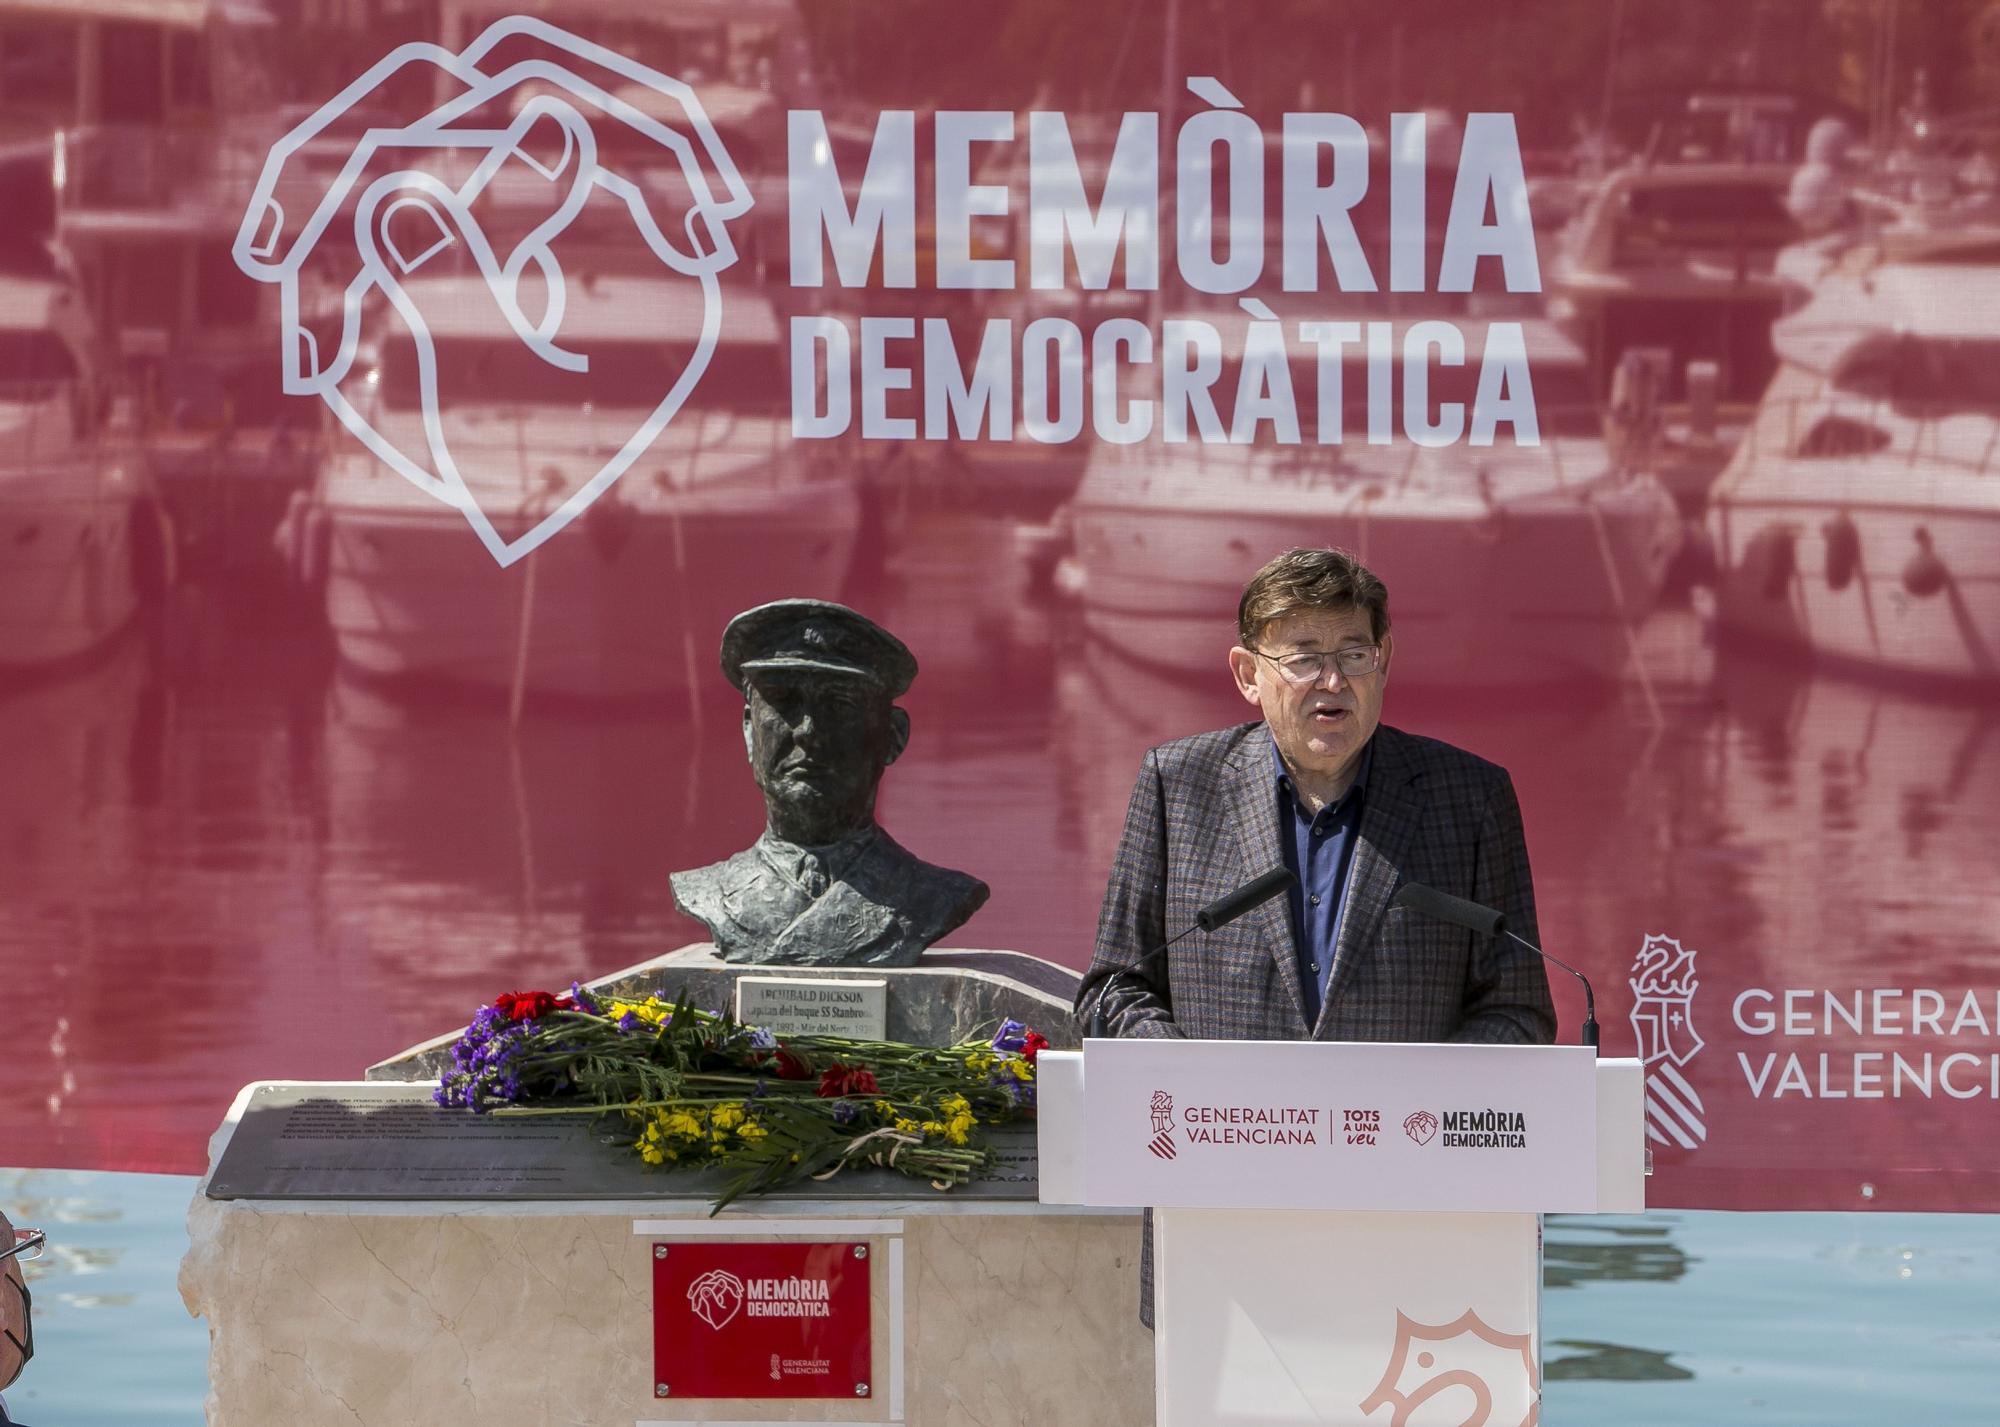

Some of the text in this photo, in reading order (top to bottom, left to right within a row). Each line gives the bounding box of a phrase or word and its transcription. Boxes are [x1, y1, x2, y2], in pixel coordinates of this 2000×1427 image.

[788, 77, 1543, 293] MEMÒRIA
[789, 298, 1542, 447] DEMOCRÀTICA
[819, 990, 864, 1003] DICKSON
[821, 1006, 831, 1018] SS
[832, 1006, 873, 1018] Stanbro
[1737, 1052, 1999, 1100] VALENCI
[1184, 1107, 1319, 1125] GENERALITAT
[1343, 1109, 1380, 1122] TOTS
[1443, 1108, 1526, 1132] MEMÒRIA
[1343, 1123, 1380, 1132] A UNA
[1186, 1128, 1317, 1145] VALENCIANA
[1346, 1133, 1376, 1146] veu
[1443, 1131, 1526, 1149] DEMOCRÀTICA
[747, 1275, 829, 1300] MEMÒRIA
[747, 1300, 830, 1317] DEMOCRÀTICA
[782, 1359, 830, 1367] GENERALITAT
[783, 1367, 829, 1375] VALENCIANA
